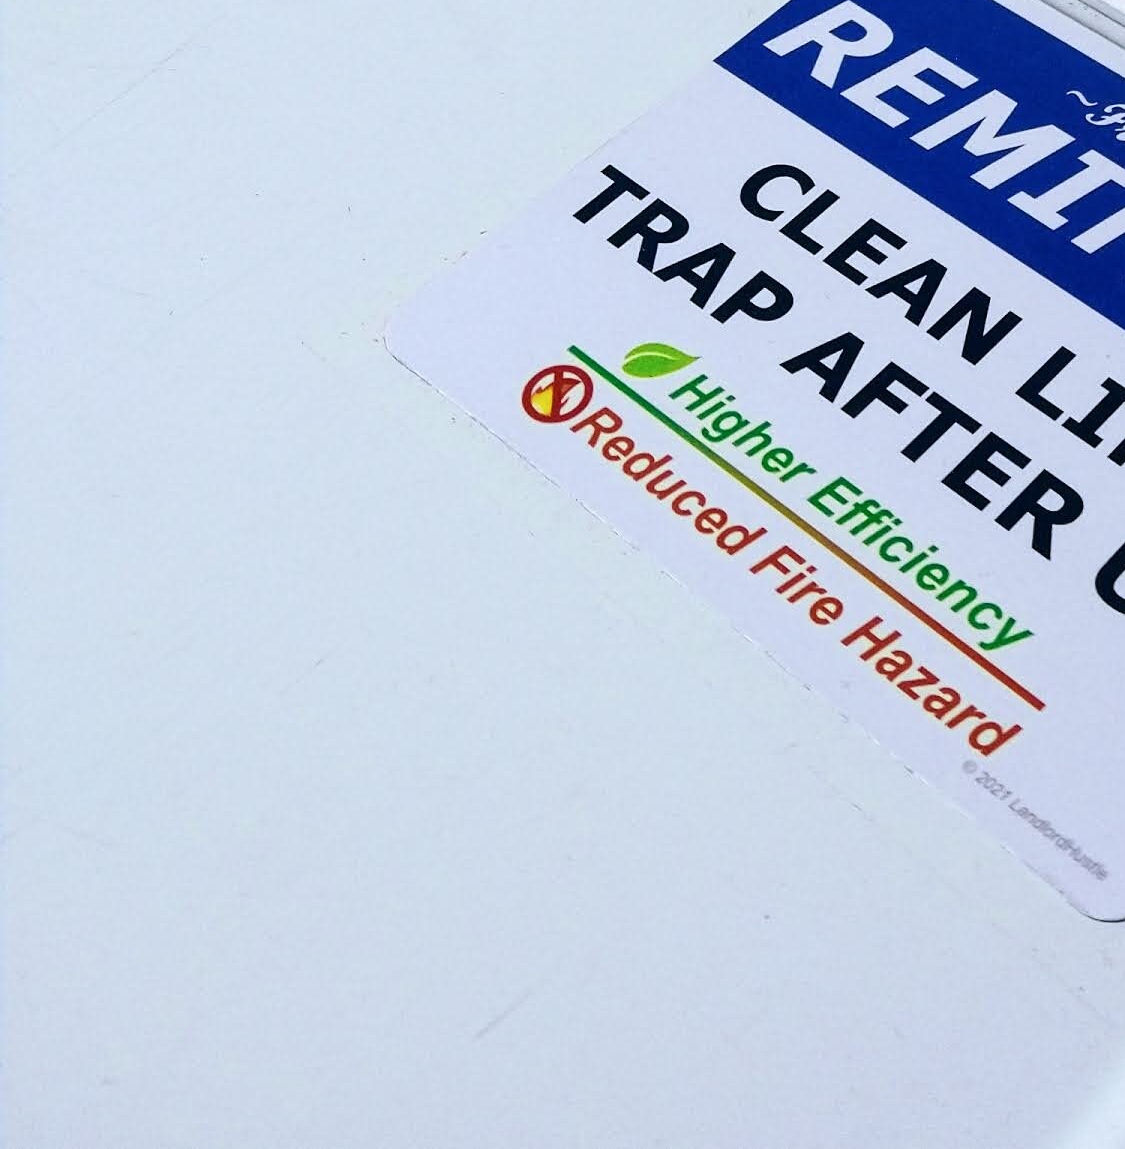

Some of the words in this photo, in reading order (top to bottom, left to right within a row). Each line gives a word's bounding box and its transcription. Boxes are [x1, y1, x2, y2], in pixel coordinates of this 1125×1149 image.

[572, 164, 795, 325] TRAP
[779, 331, 1085, 561] AFTER
[739, 164, 1023, 366] CLEAN
[569, 406, 768, 556] Reduced
[749, 545, 845, 627] Fire
[840, 616, 1024, 757] Hazard
[668, 373, 817, 483] Higher
[806, 476, 1035, 652] Efficiency
[975, 770, 1013, 800] 2021
